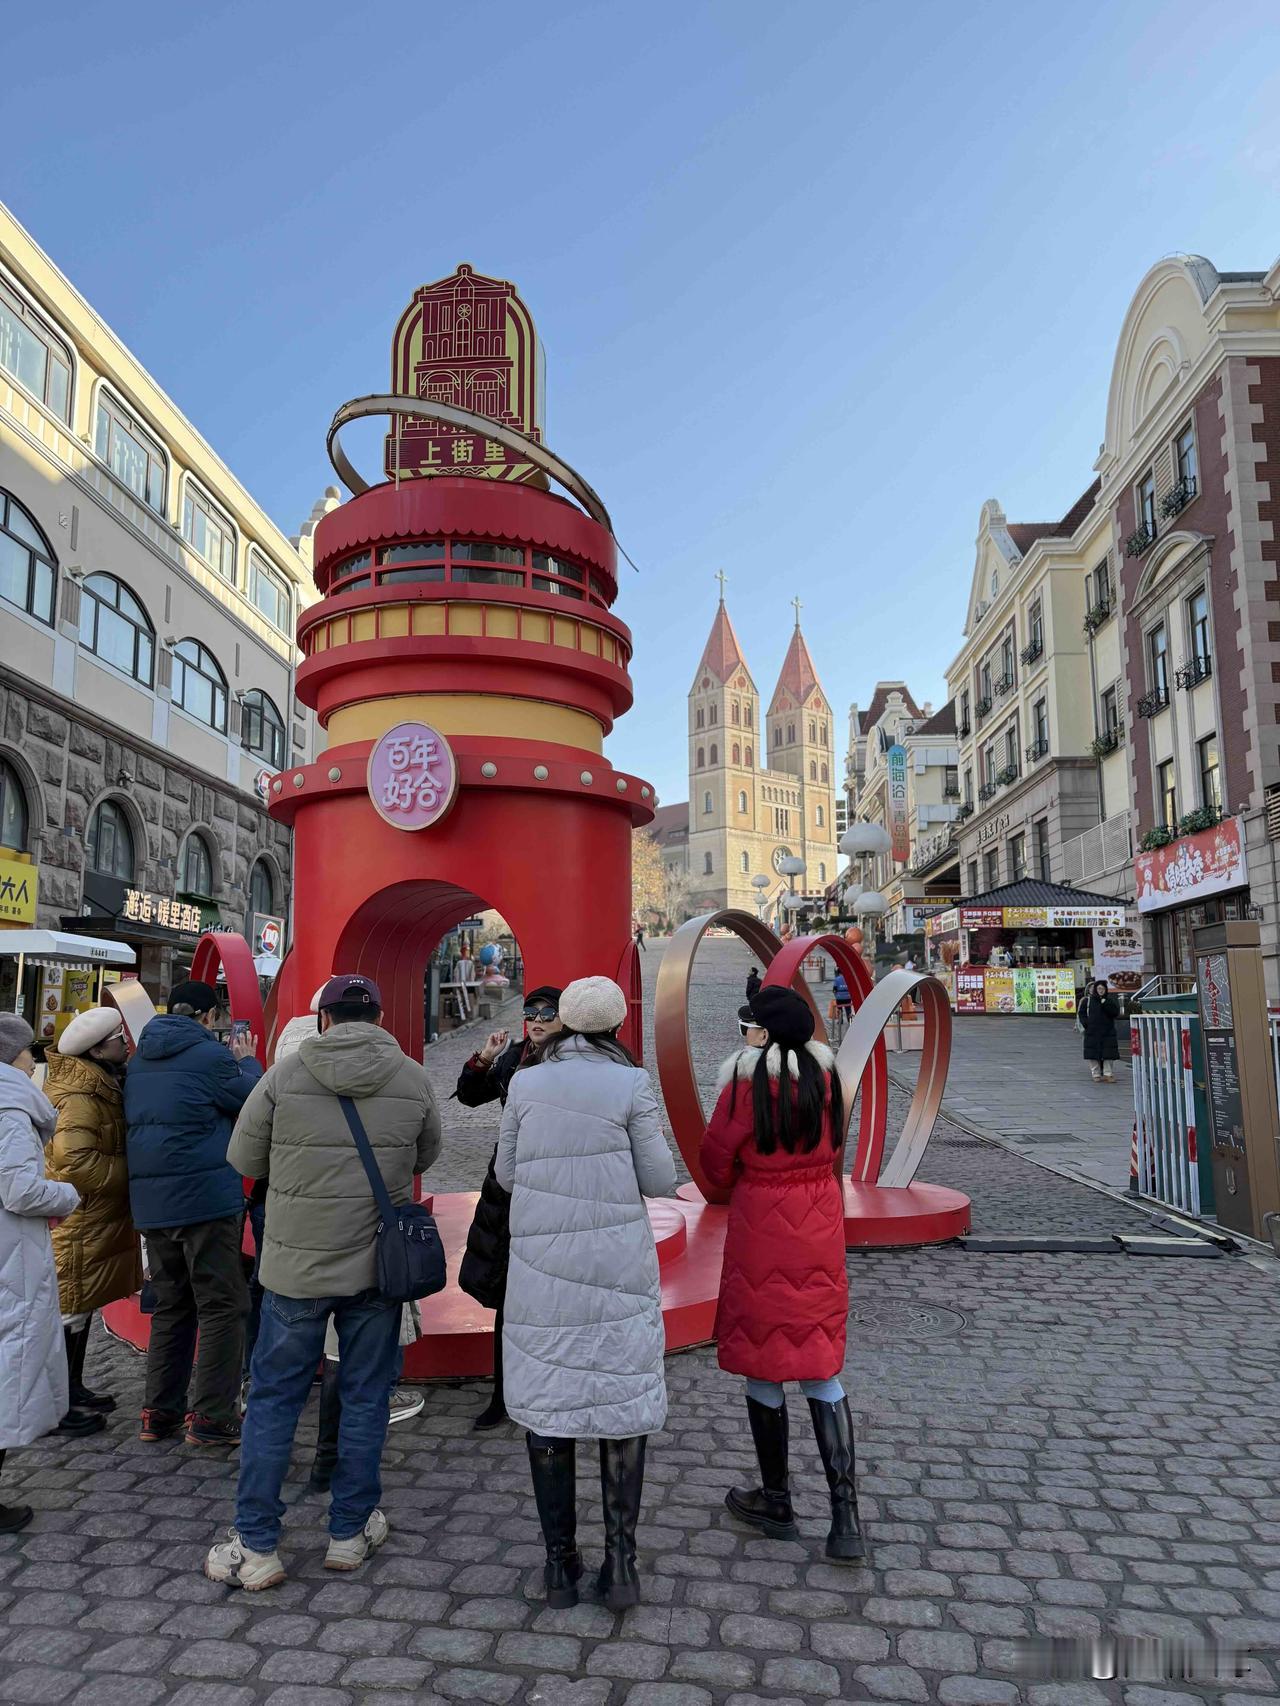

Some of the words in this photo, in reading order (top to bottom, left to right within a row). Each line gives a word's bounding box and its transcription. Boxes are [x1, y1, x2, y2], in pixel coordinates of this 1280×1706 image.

[419, 438, 506, 465] 上街里
[385, 734, 441, 772] 百年
[382, 770, 443, 811] 好合
